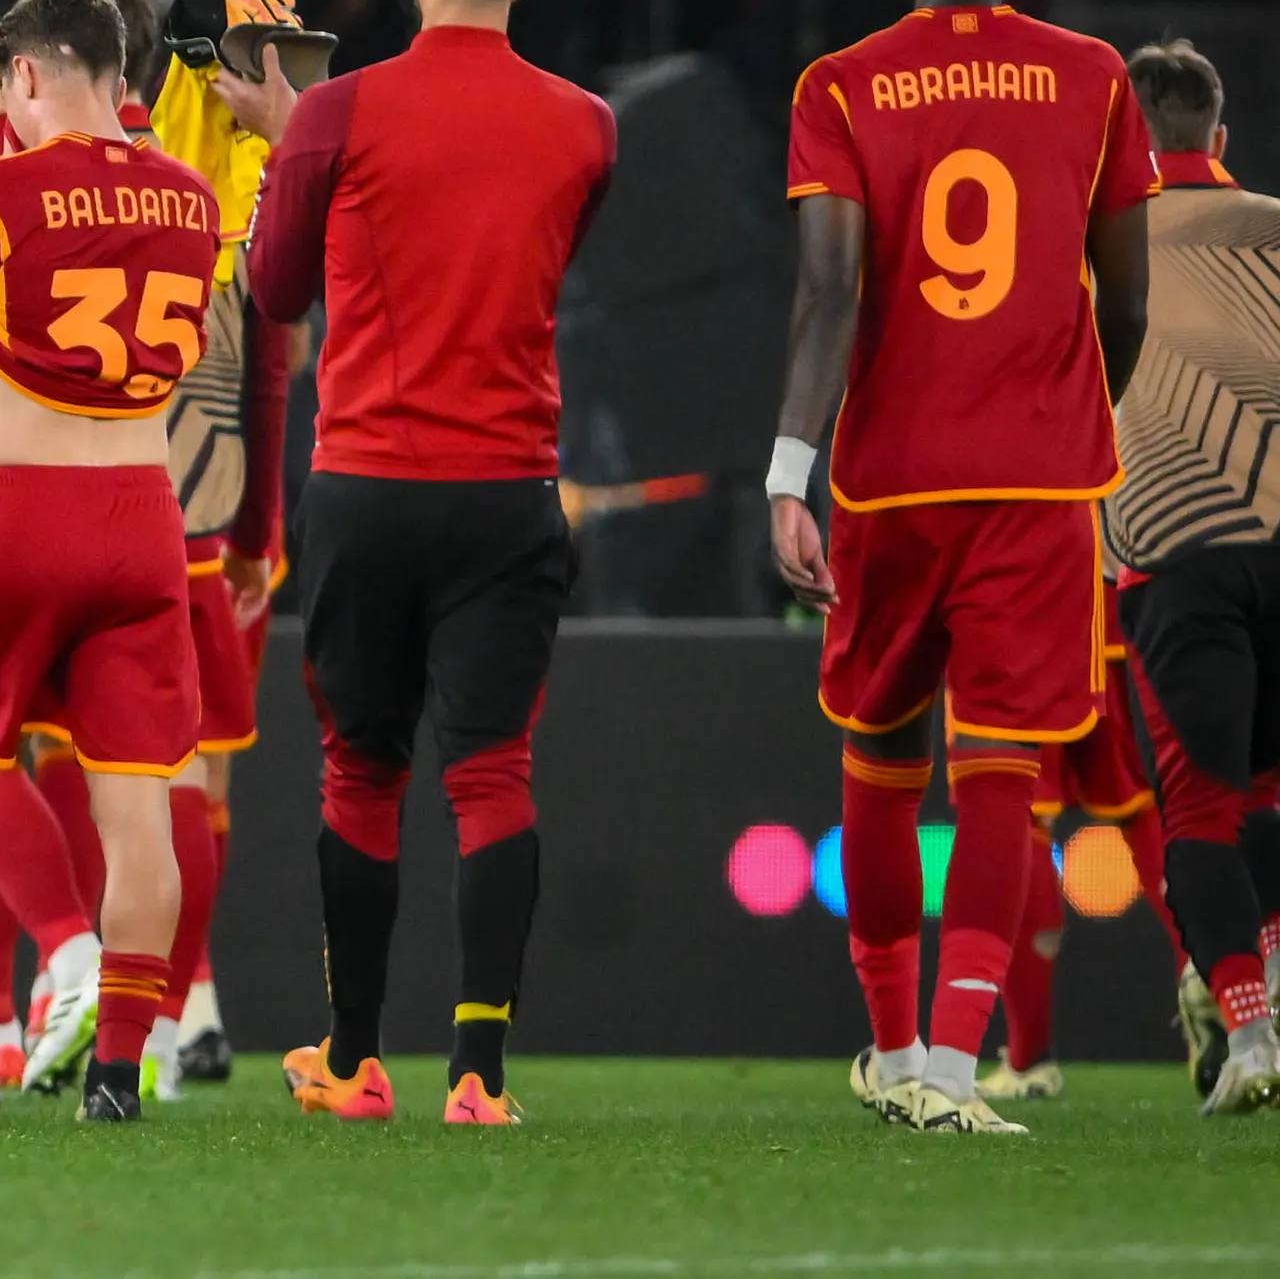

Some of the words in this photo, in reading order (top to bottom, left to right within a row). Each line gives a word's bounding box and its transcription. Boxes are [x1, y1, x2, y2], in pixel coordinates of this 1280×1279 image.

[871, 60, 1057, 110] ABRAHAM
[41, 186, 208, 234] BALDANZI
[919, 148, 1018, 320] 9
[46, 267, 204, 400] 35
